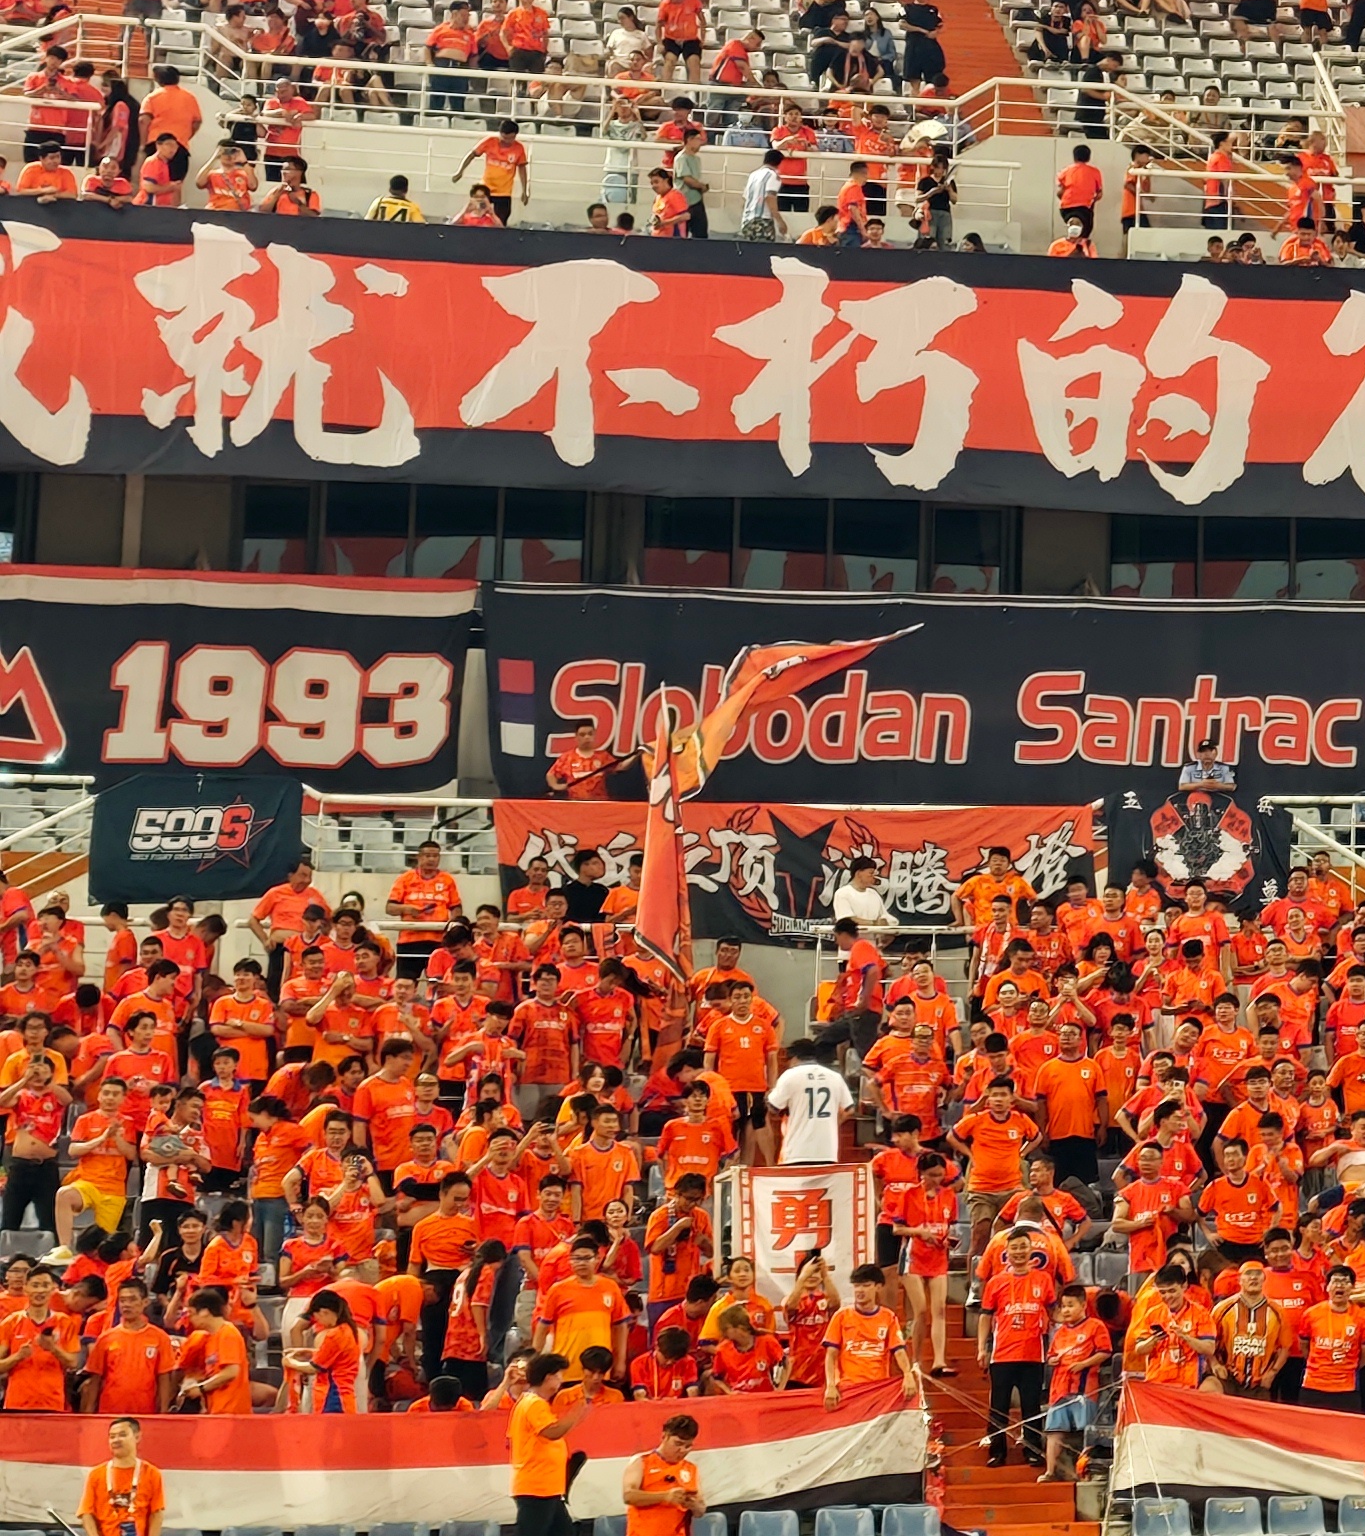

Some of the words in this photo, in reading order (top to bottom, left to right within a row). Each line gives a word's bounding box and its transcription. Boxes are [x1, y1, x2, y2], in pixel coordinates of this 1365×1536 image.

[102, 640, 454, 770] 1993
[546, 659, 973, 768] Slobodan
[1014, 669, 1363, 770] Santrac
[804, 1086, 832, 1120] 12
